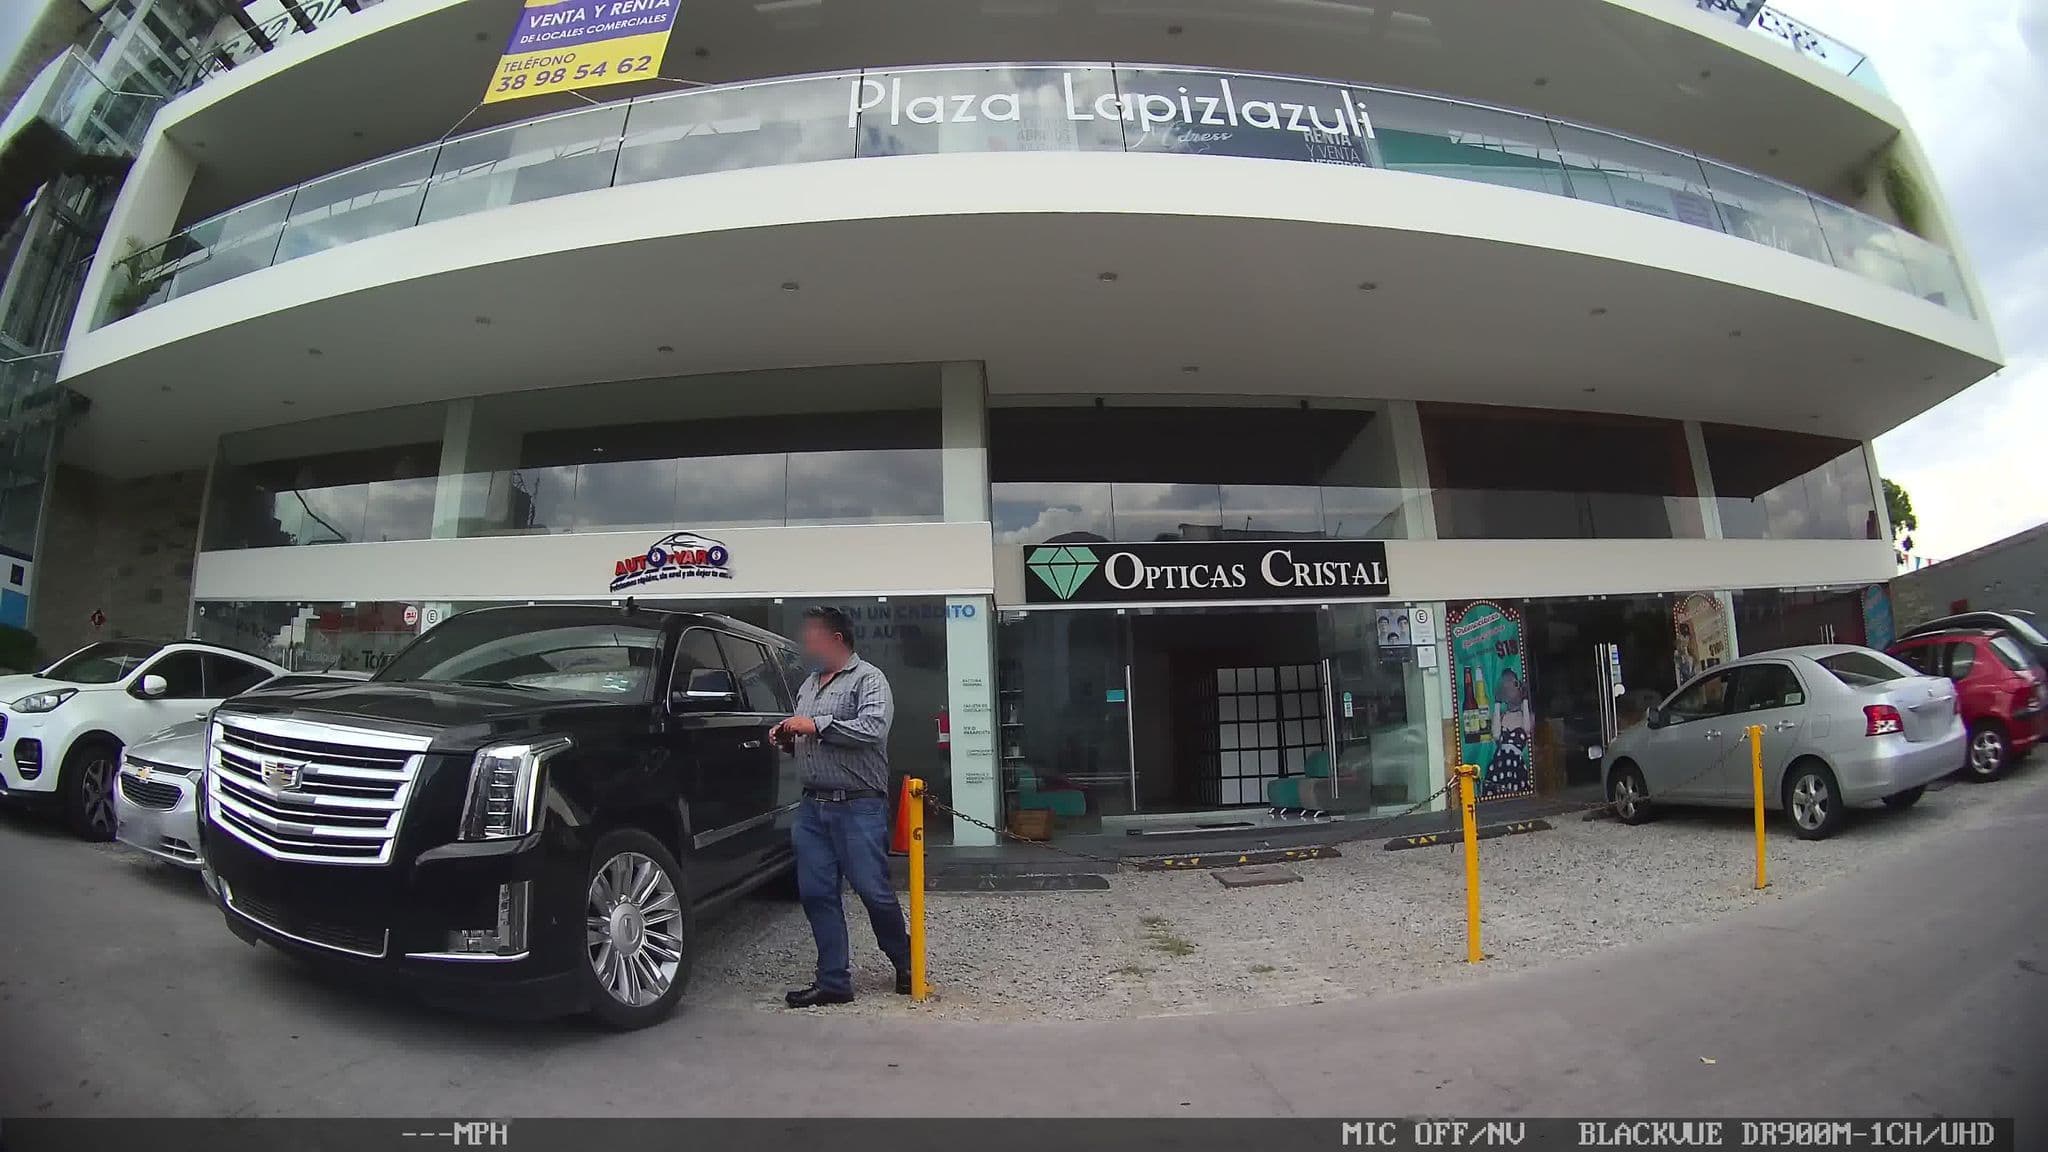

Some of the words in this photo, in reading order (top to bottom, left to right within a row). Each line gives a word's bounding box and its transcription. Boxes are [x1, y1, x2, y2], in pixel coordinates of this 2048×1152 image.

[520, 34, 535, 44] DE
[536, 27, 585, 43] LOCALES
[586, 13, 667, 34] COMERCIALES
[529, 11, 586, 28] VENTA
[593, 4, 605, 18] Y
[610, 0, 671, 16] RENTA
[496, 75, 527, 93] 38
[534, 68, 567, 86] 98
[573, 61, 607, 80] 54
[617, 55, 652, 74] 62
[504, 53, 577, 73] TELÉFONO
[848, 77, 1020, 129] Plaza
[1063, 72, 1376, 139] Lapizlazuli
[1305, 143, 1314, 157] Y
[1318, 145, 1361, 162] VENTA
[1104, 551, 1246, 590] OPTICAS
[1260, 549, 1388, 587] CRISTAL
